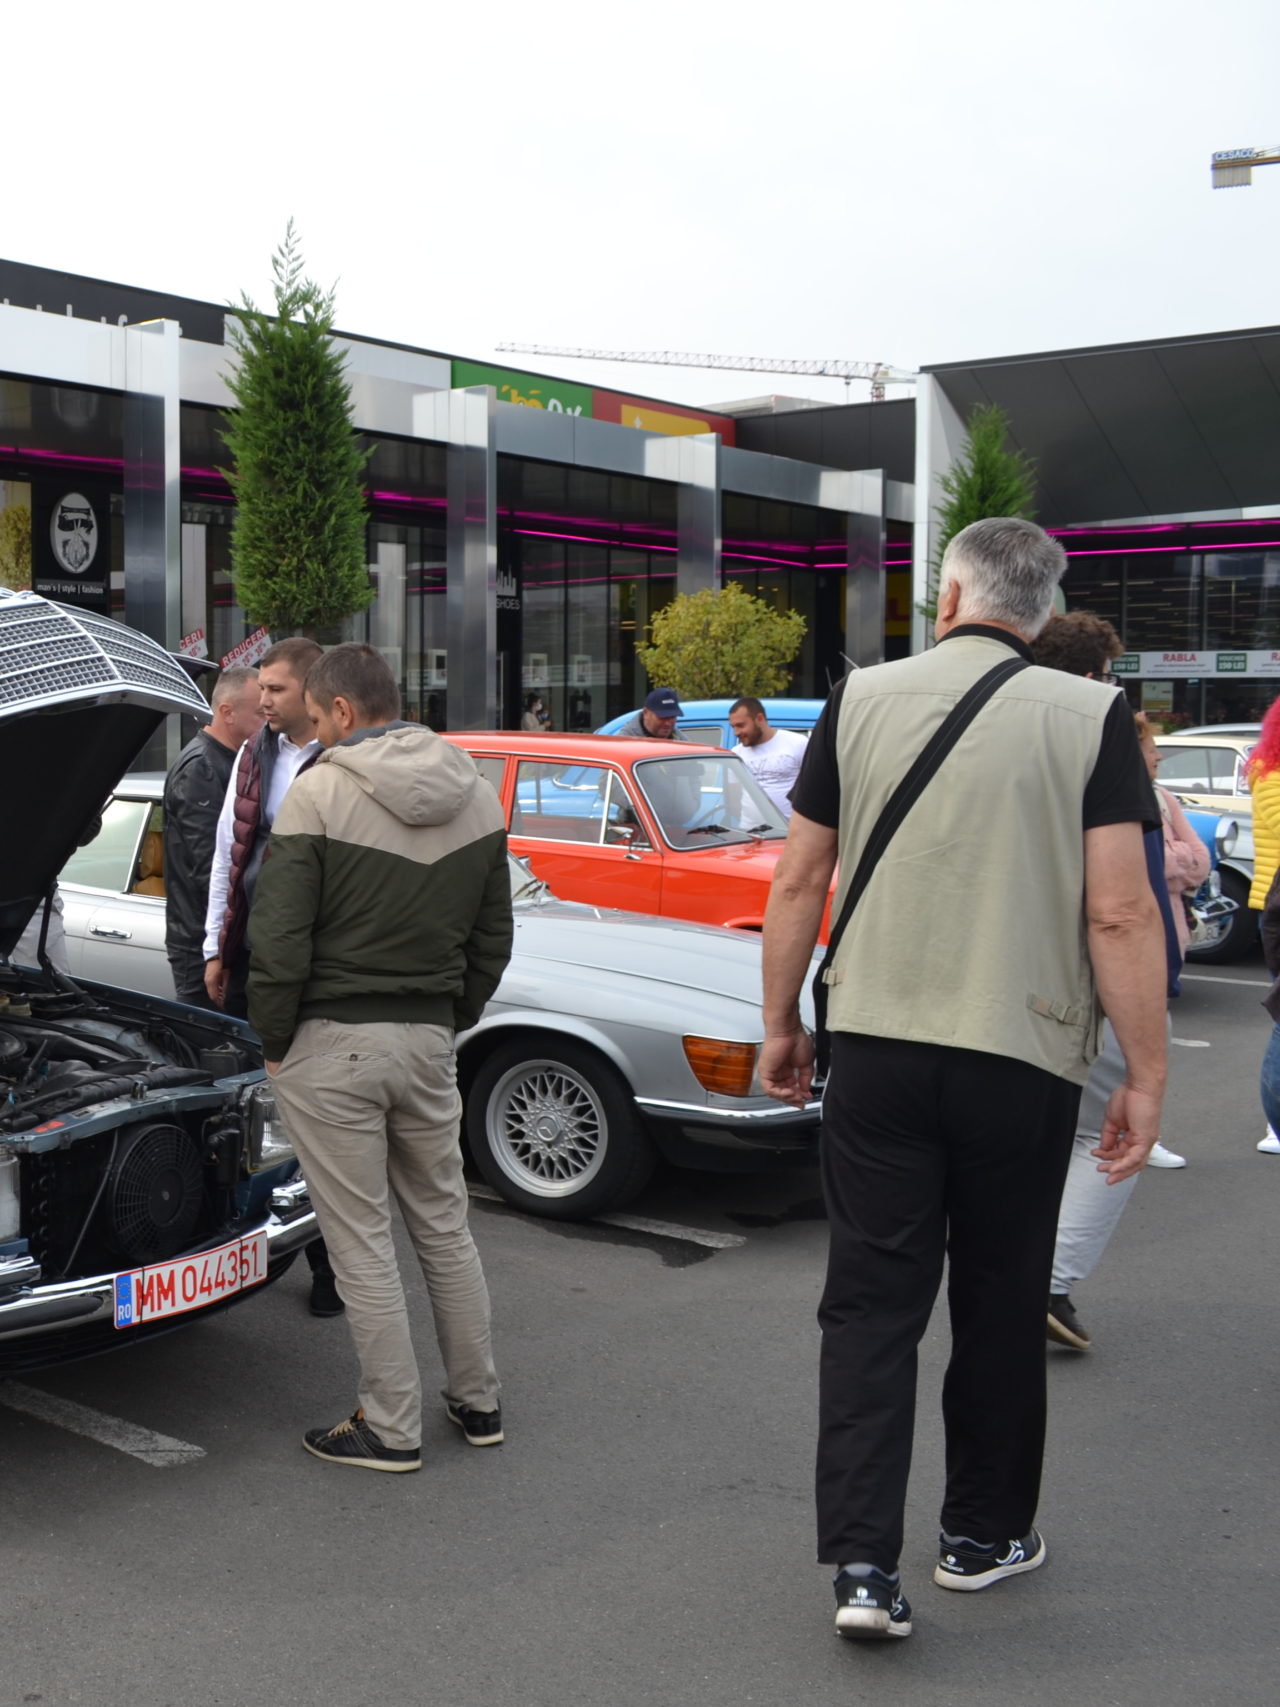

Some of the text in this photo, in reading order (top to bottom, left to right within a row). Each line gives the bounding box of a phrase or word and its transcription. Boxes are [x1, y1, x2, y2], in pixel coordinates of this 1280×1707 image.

[62, 584, 77, 594] style
[82, 585, 104, 594] fashion
[496, 598, 521, 610] SHOES
[222, 626, 267, 667] REDUCERI
[1162, 653, 1197, 662] RABLA
[119, 1304, 132, 1321] RO
